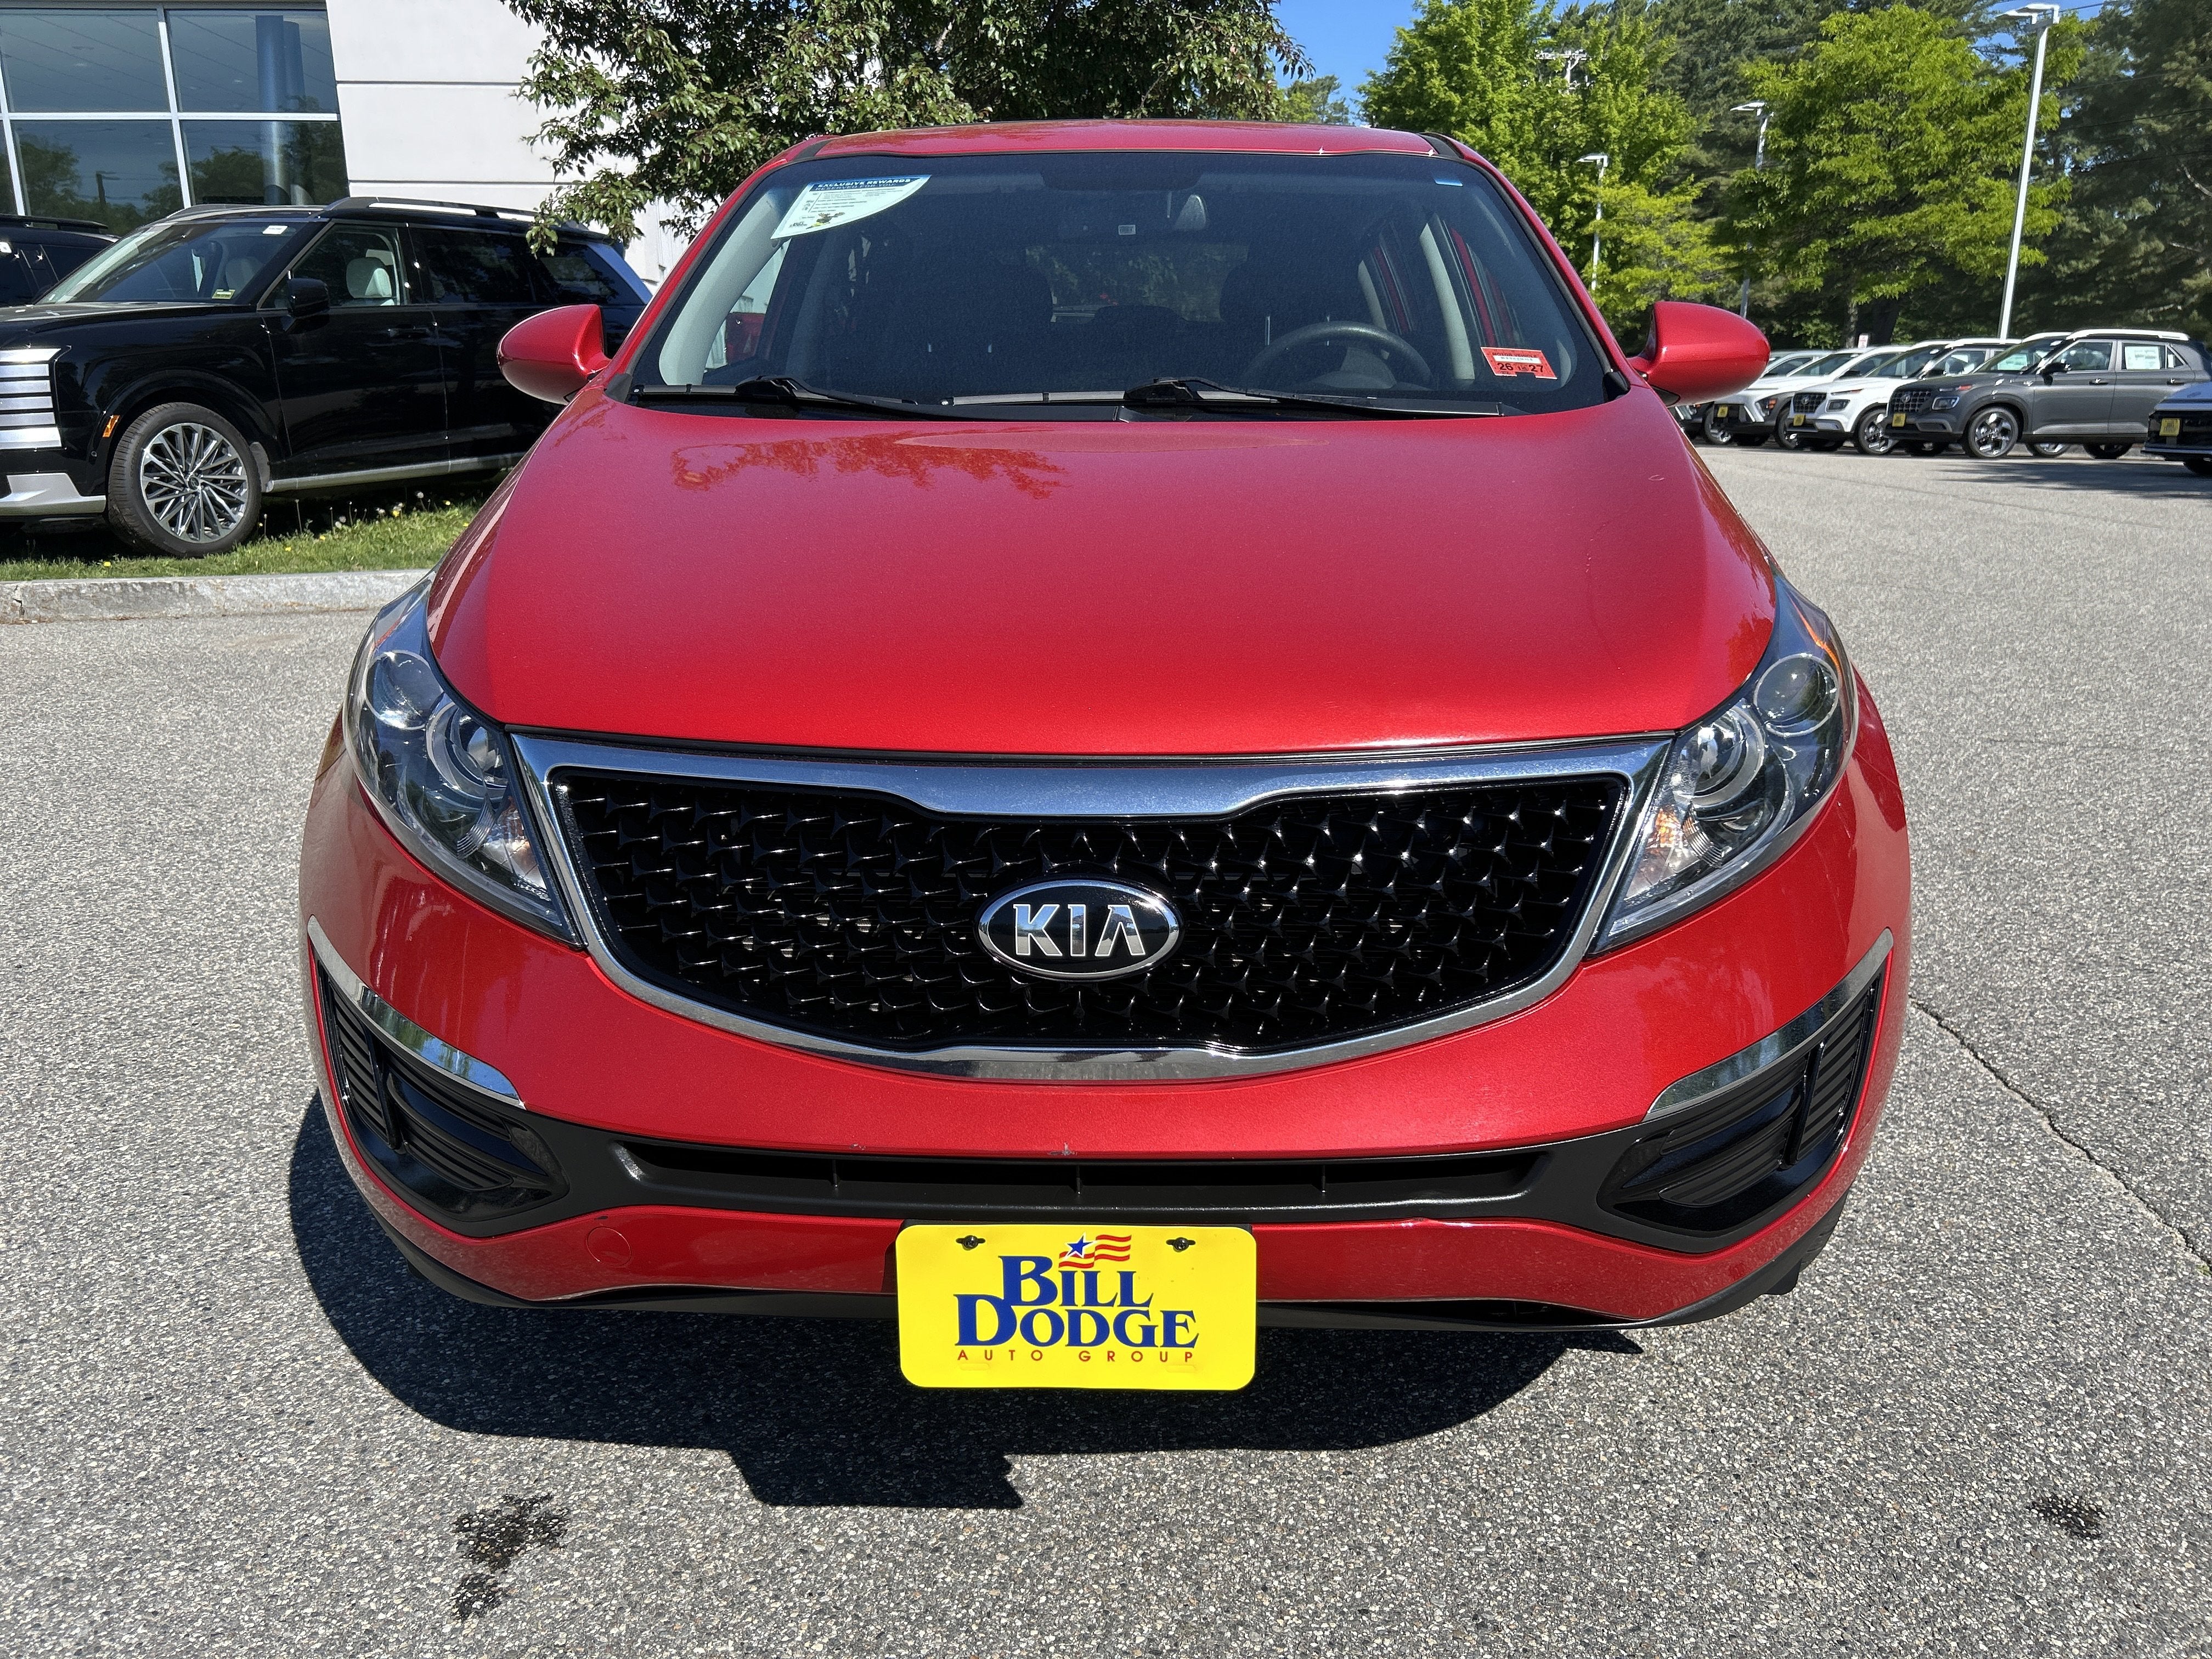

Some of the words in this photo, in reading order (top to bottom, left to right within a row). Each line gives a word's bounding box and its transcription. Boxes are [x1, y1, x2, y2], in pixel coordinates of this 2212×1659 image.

[1497, 363, 1514, 371] 26
[1528, 364, 1543, 373] 27
[1013, 904, 1146, 957] KIA
[998, 1255, 1154, 1308] BILL
[953, 1293, 1199, 1349] DODGE
[957, 1349, 1044, 1362] AUTO
[1078, 1350, 1194, 1363] GROUP
